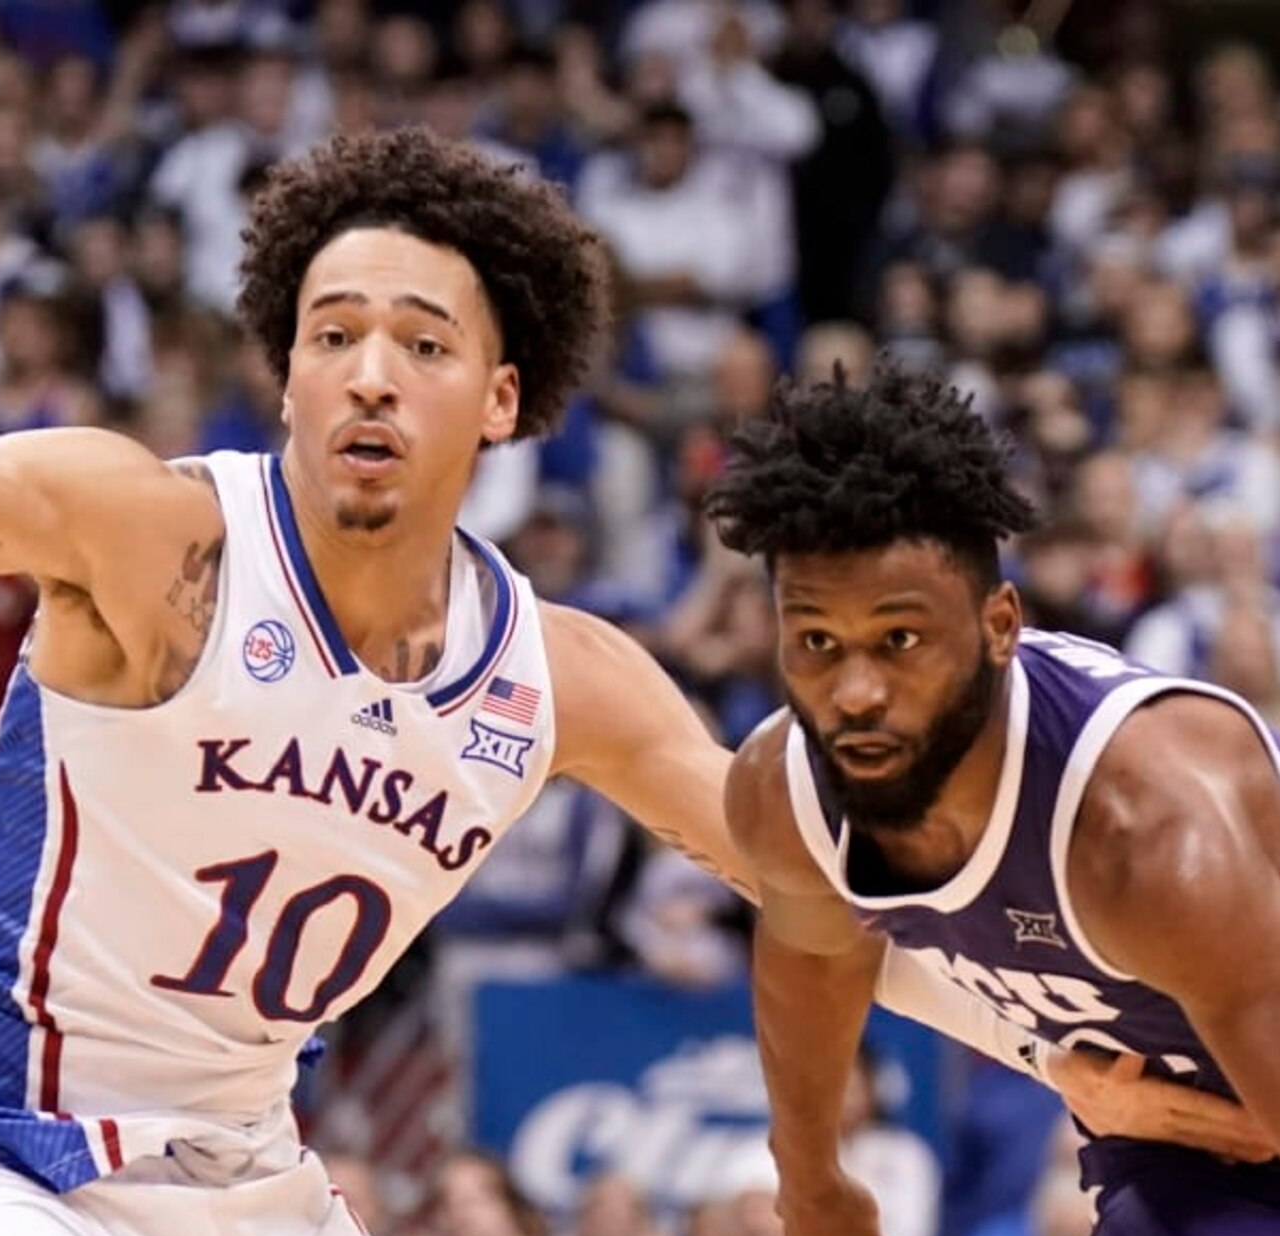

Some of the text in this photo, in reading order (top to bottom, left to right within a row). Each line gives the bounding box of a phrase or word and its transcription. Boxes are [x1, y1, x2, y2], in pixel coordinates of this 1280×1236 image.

[350, 712, 398, 737] adidas
[195, 737, 492, 871] KANSAS
[150, 849, 391, 1022] 10
